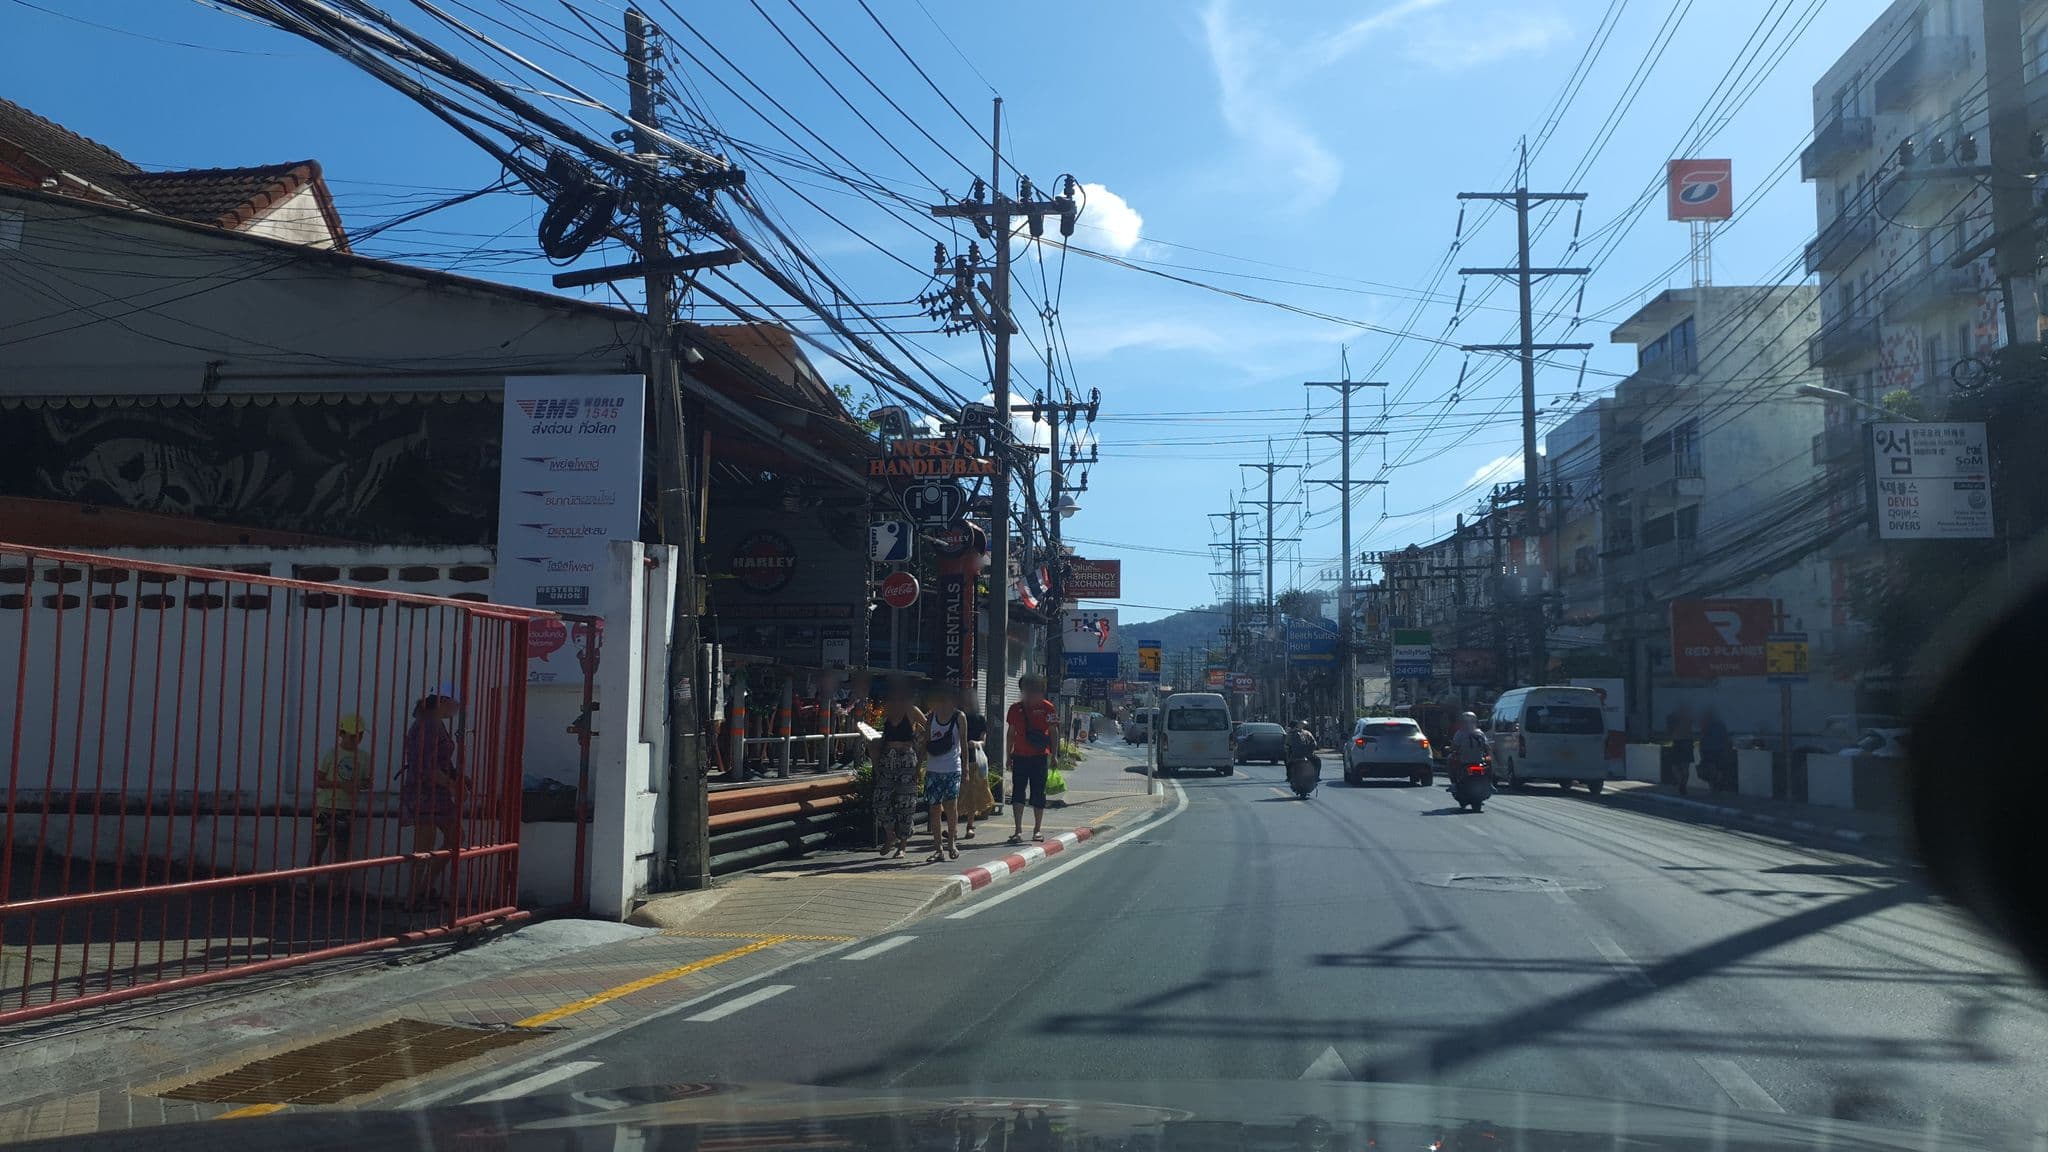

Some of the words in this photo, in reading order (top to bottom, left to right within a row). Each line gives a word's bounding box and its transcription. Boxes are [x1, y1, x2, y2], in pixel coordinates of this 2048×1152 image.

[534, 399, 580, 419] EMS
[584, 397, 625, 408] WORLD
[586, 408, 619, 419] 1545
[531, 420, 573, 435] ส่งด่วน
[578, 419, 617, 435] ทั่วโลก
[869, 458, 997, 476] HANDLEBAR
[1887, 496, 1919, 508] DEVILS
[1888, 520, 1921, 531] DIVERS
[732, 557, 795, 569] HARLEY
[1069, 580, 1116, 588] EXCHANGE
[550, 592, 581, 600] UNION
[946, 583, 961, 657] RENTALS
[1289, 642, 1312, 650] Hotel
[1684, 646, 1710, 657] RED
[1714, 645, 1765, 657] PLANET
[1066, 655, 1088, 666] ATM
